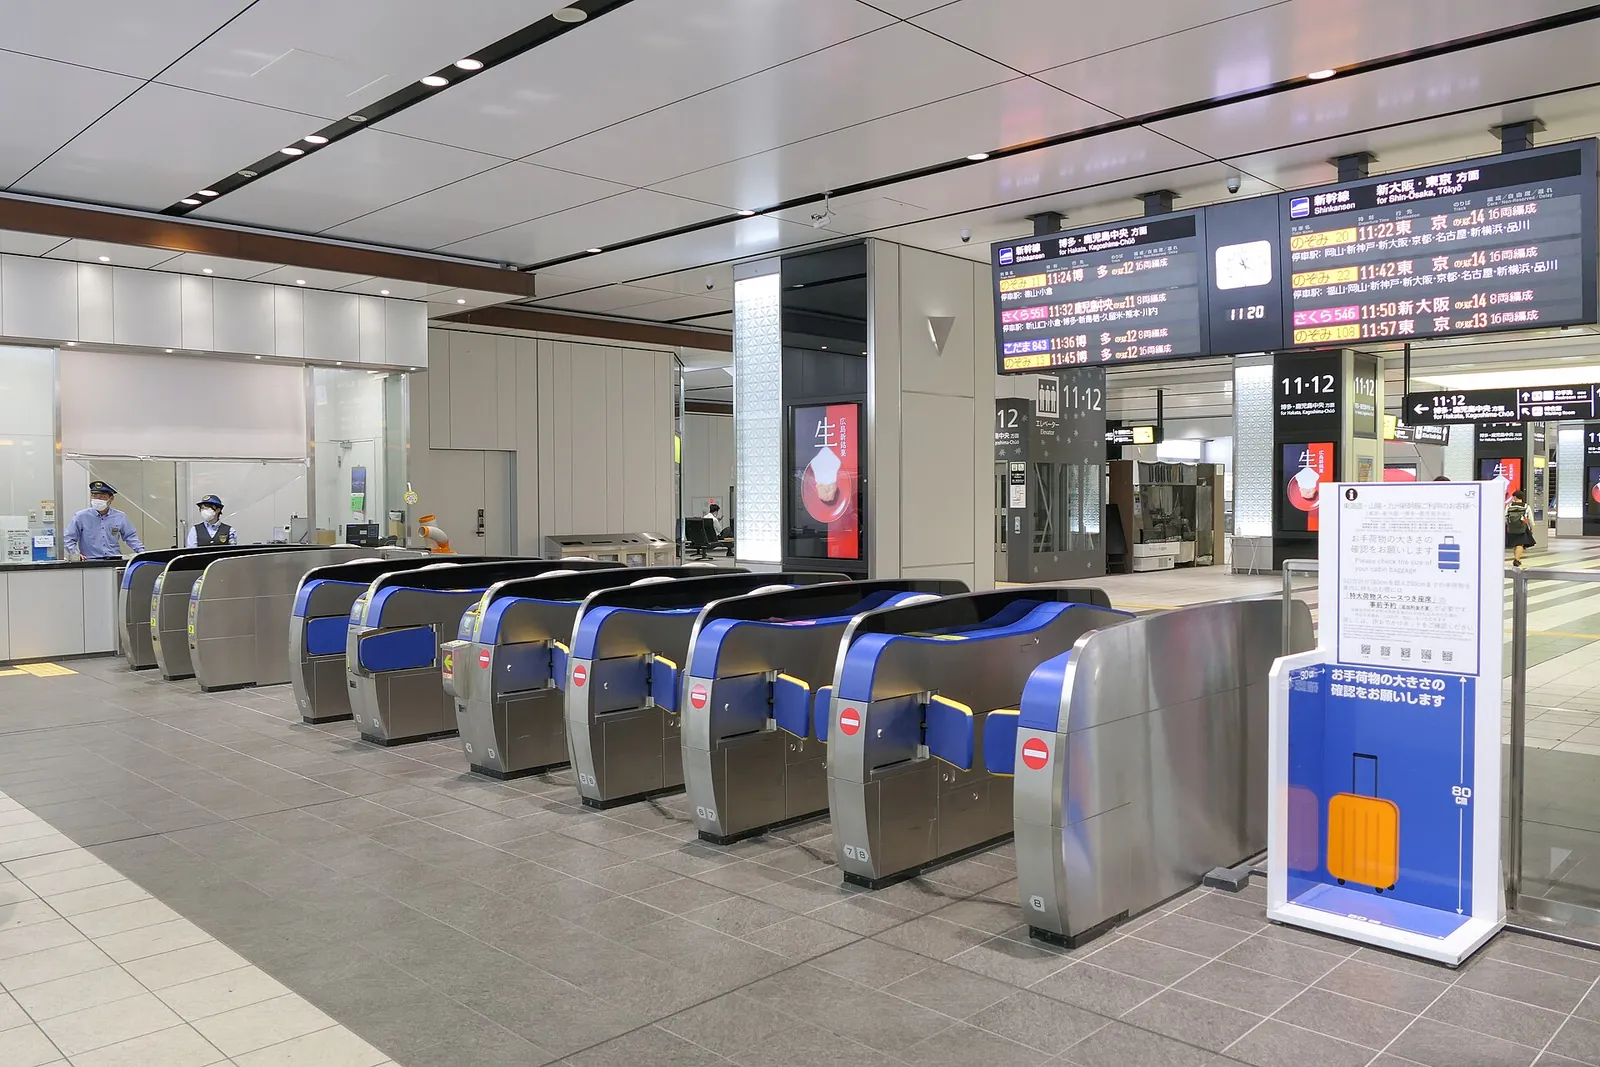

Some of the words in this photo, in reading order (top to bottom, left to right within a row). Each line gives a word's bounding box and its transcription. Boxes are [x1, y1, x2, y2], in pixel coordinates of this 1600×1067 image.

[1457, 170, 1479, 183] 方面
[1314, 191, 1350, 205] 新幹線
[1377, 196, 1388, 204] for
[1314, 202, 1355, 215] Shinkansen
[1131, 226, 1148, 236] 方面
[1292, 237, 1328, 249] のぞみ
[1336, 231, 1349, 242] 20
[1359, 224, 1393, 241] 11:22
[1016, 243, 1040, 255] 新幹線
[1016, 253, 1045, 263] Shinkansen
[1047, 272, 1071, 285] 11:24
[1294, 274, 1330, 286] のぞみ
[1361, 264, 1395, 280] 11:42
[1002, 310, 1029, 322] さくら
[1031, 309, 1045, 318] 551
[1049, 303, 1074, 317] 11:32
[1294, 312, 1332, 324] さくら
[1335, 309, 1355, 320] 546
[1362, 303, 1396, 319] 11:50
[1398, 297, 1450, 316] 新大阪
[1295, 329, 1331, 342] のぞみ
[1362, 322, 1396, 337] 11:57
[1004, 342, 1031, 353] こだま
[1032, 340, 1047, 350] 843
[1051, 336, 1074, 350] 11:36
[1052, 351, 1075, 365] 11:45
[998, 409, 1018, 428] 12
[814, 416, 838, 447] 生
[1298, 449, 1317, 467] 生
[1493, 463, 1508, 476] 生
[1352, 535, 1433, 544] お手荷物の大きさの
[1351, 545, 1433, 554] 確認をお願いします
[1300, 670, 1309, 680] 30
[1331, 668, 1445, 691] お手荷物の大きさの
[1331, 683, 1445, 708] 確認をお願いします
[1452, 785, 1472, 798] 80
[1033, 898, 1042, 908] 8
